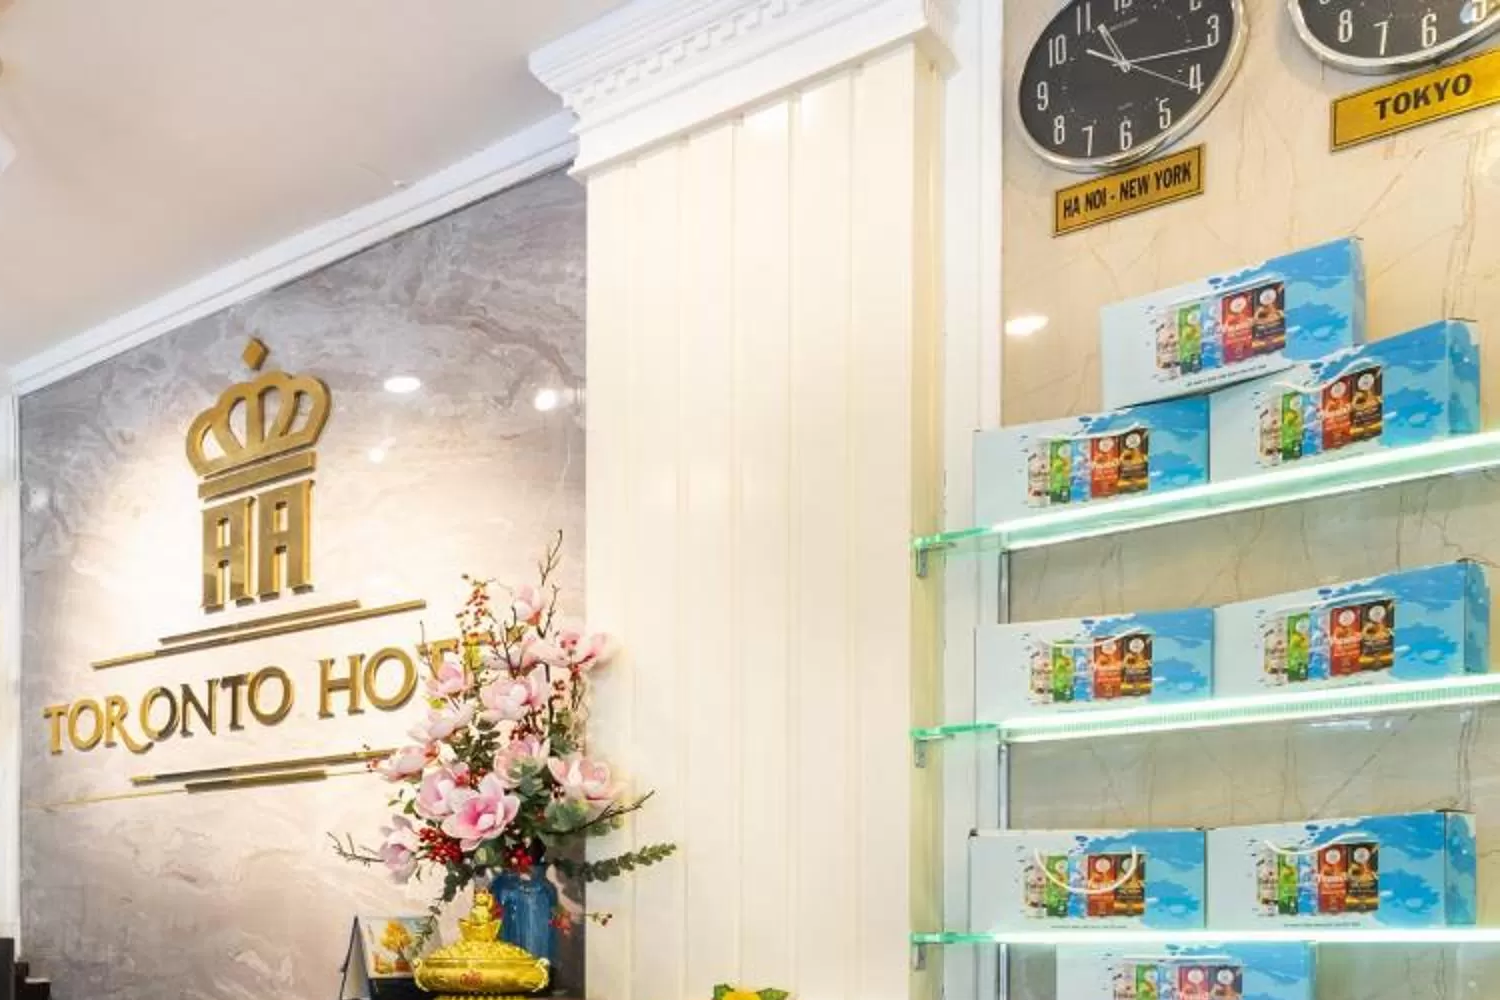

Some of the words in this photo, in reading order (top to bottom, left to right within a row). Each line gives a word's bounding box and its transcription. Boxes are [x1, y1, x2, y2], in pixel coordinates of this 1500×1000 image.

[1206, 14, 1220, 46] 3
[1338, 9, 1353, 43] 8
[1372, 21, 1389, 56] 7
[1421, 12, 1437, 48] 6
[1048, 34, 1067, 68] 10
[1188, 63, 1204, 95] 4
[1037, 81, 1049, 111] 9
[1374, 73, 1473, 121] TOKYO
[1053, 115, 1066, 145] 8
[1157, 98, 1171, 129] 5
[1081, 125, 1094, 157] 7
[1119, 119, 1133, 151] 6
[1063, 196, 1081, 220] HA
[1085, 187, 1107, 213] NOI
[1119, 175, 1150, 202] NEW
[1154, 160, 1192, 191] YORK
[43, 665, 295, 755] TORONTO
[317, 630, 502, 720] HOT
